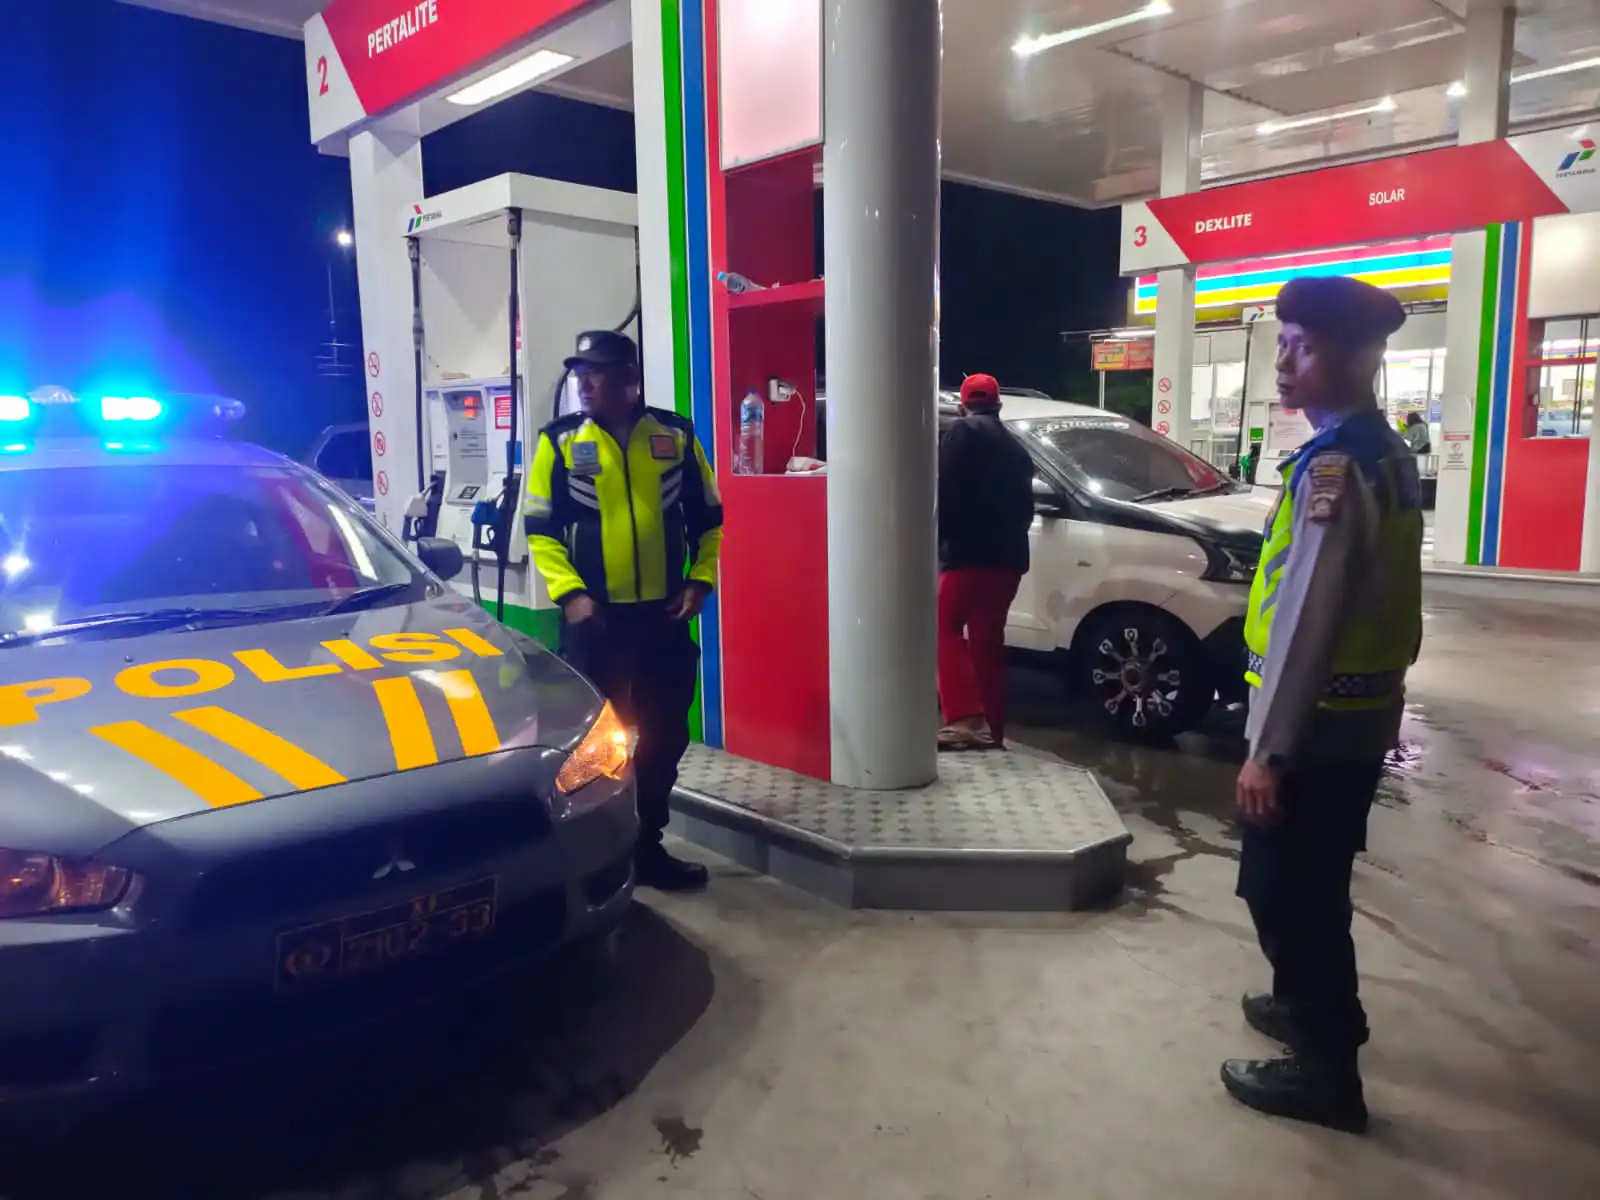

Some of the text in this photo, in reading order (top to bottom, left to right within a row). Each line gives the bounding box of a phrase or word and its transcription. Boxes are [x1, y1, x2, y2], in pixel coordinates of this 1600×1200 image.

[367, 0, 438, 58] PERTALITE
[317, 56, 328, 96] 2
[1368, 188, 1405, 206] SOLAR
[1134, 225, 1147, 247] 3
[1195, 213, 1252, 233] DEXLITE
[0, 628, 504, 727] POLISI
